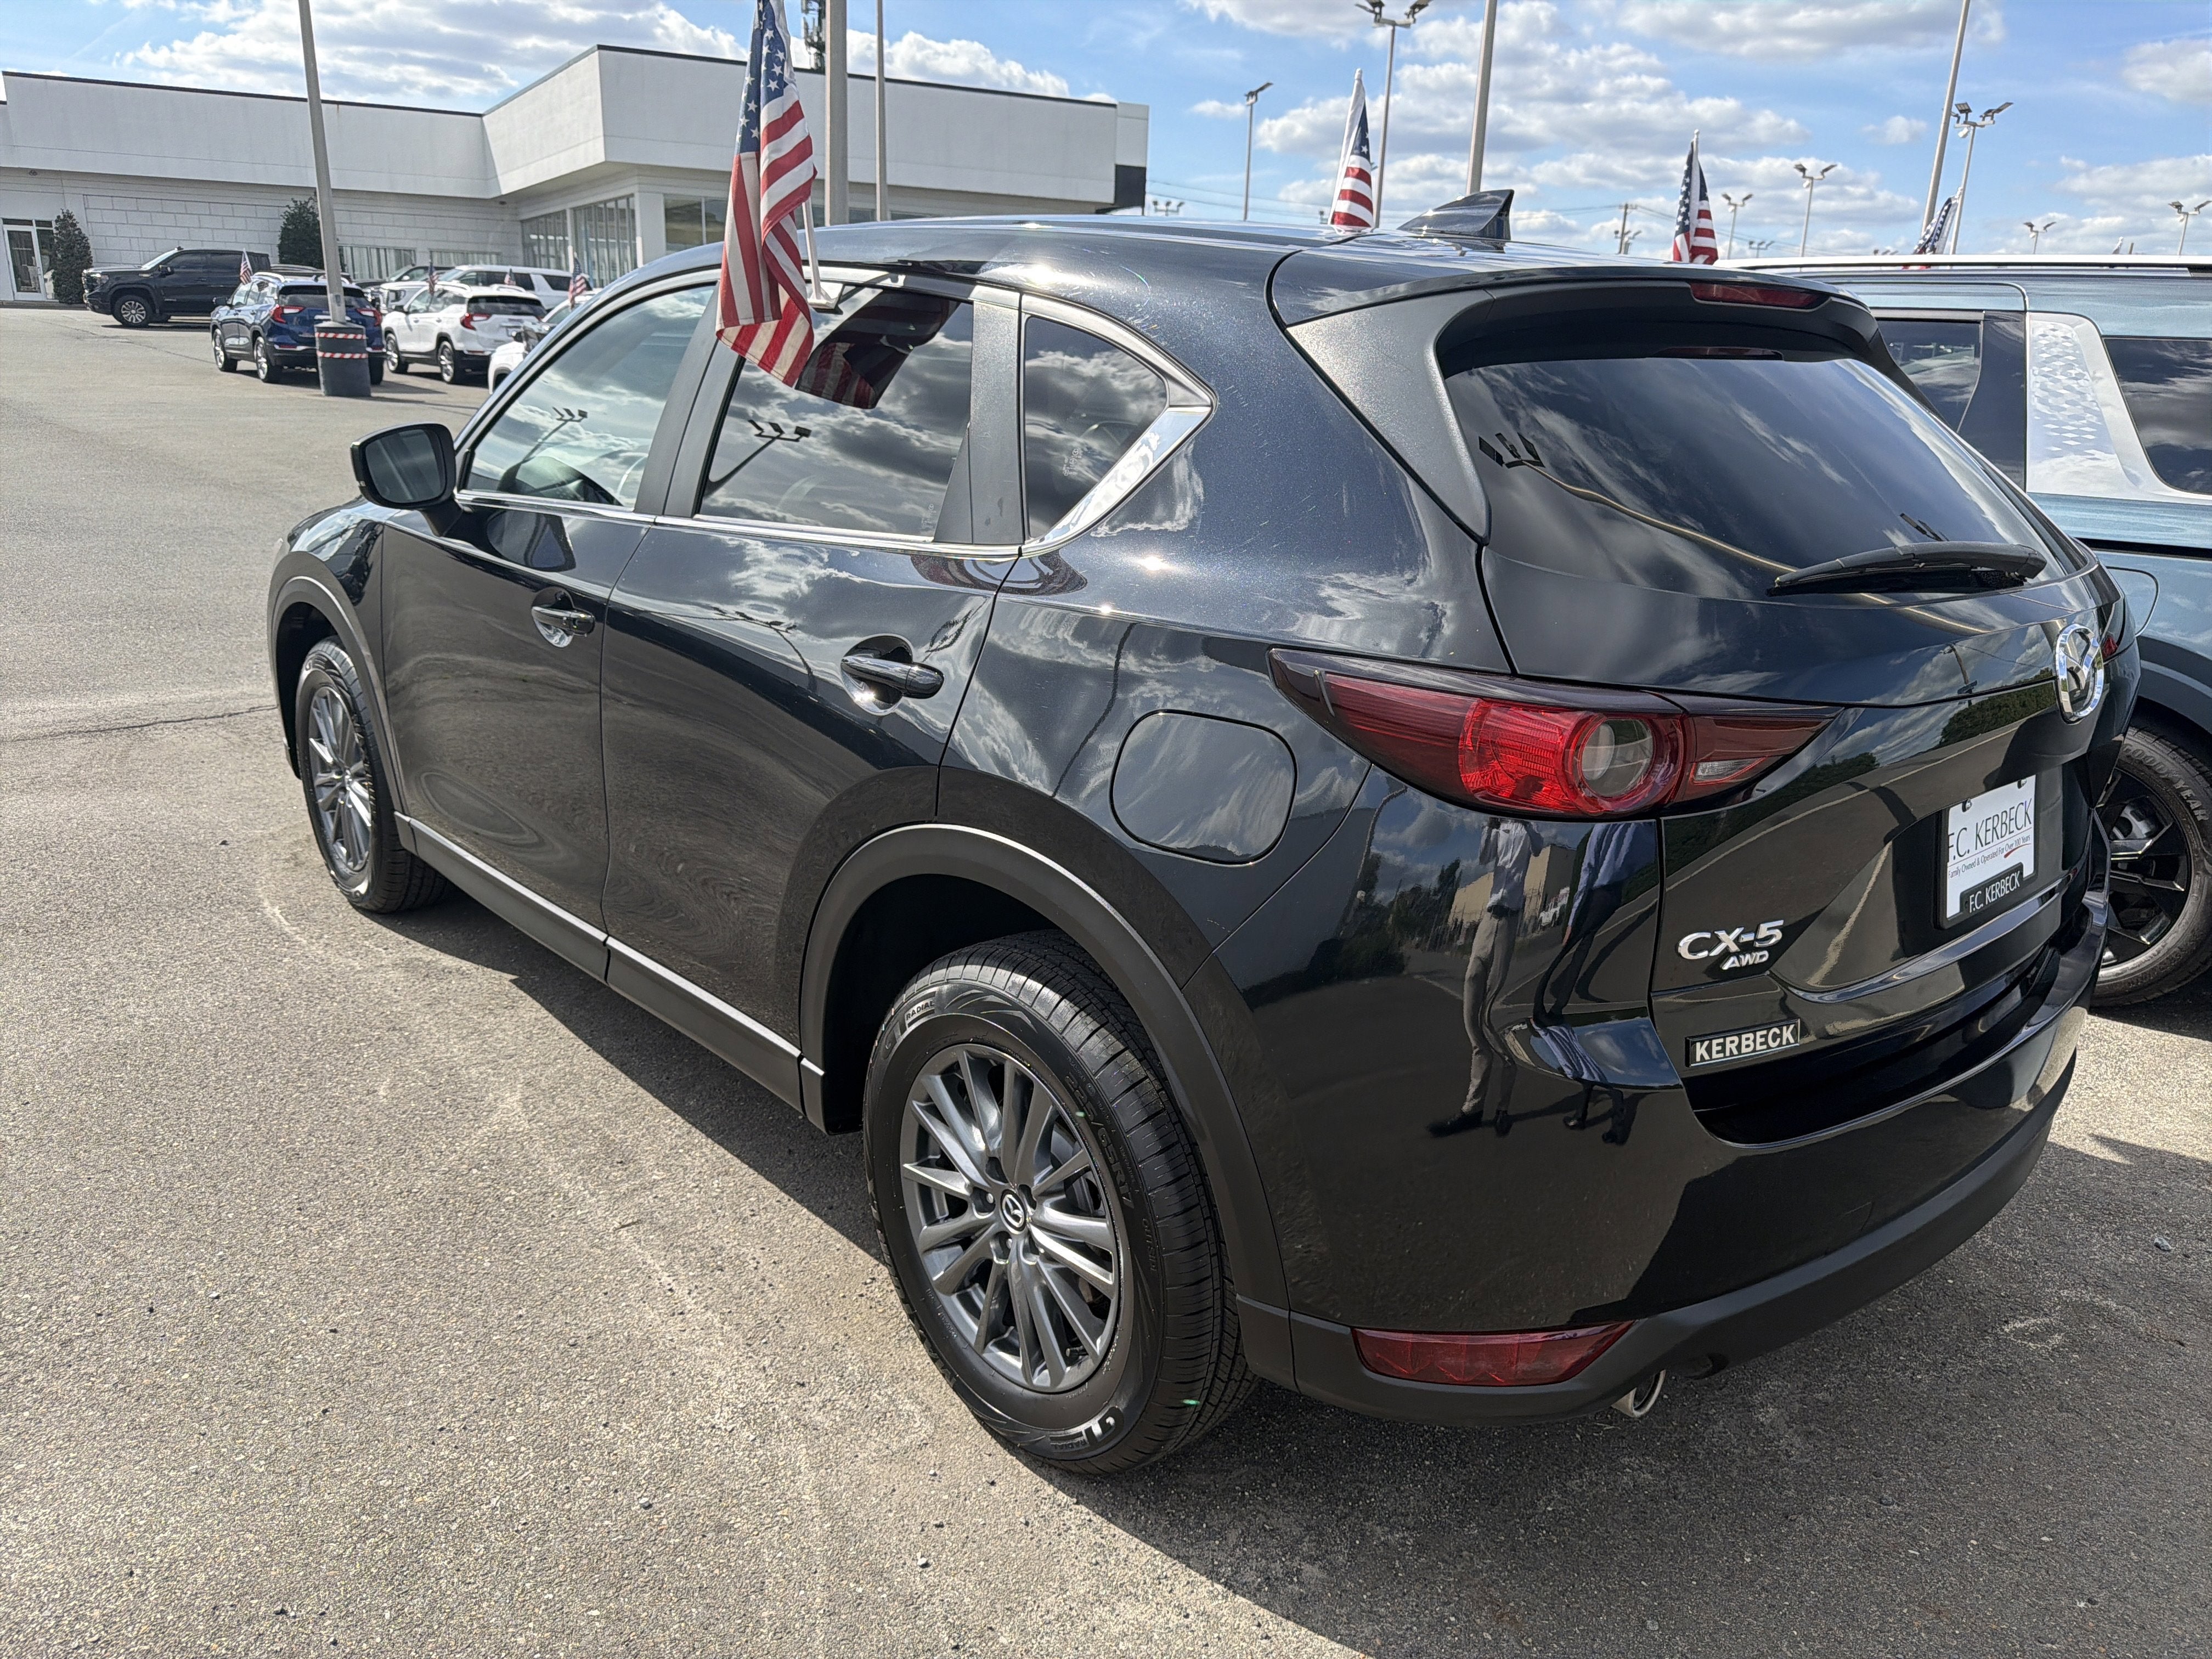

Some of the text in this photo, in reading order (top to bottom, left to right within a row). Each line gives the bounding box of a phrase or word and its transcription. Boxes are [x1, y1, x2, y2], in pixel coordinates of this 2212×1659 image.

[1948, 798, 2032, 862] F.C. KERBECK
[1949, 866, 1961, 879] Family
[1962, 859, 1976, 872] Owned
[1977, 857, 1980, 866] &
[1980, 850, 1998, 864] Operated
[2005, 843, 2015, 853] Over
[2022, 834, 2030, 844] Years
[1969, 870, 2021, 913] F.C. KERBECK
[1678, 919, 1784, 960] CX-5
[1720, 950, 1769, 970] AWD
[905, 1000, 935, 1020] RADIAL
[1695, 1024, 1796, 1062] KERBECK
[1050, 1439, 1087, 1450] RADIAL
